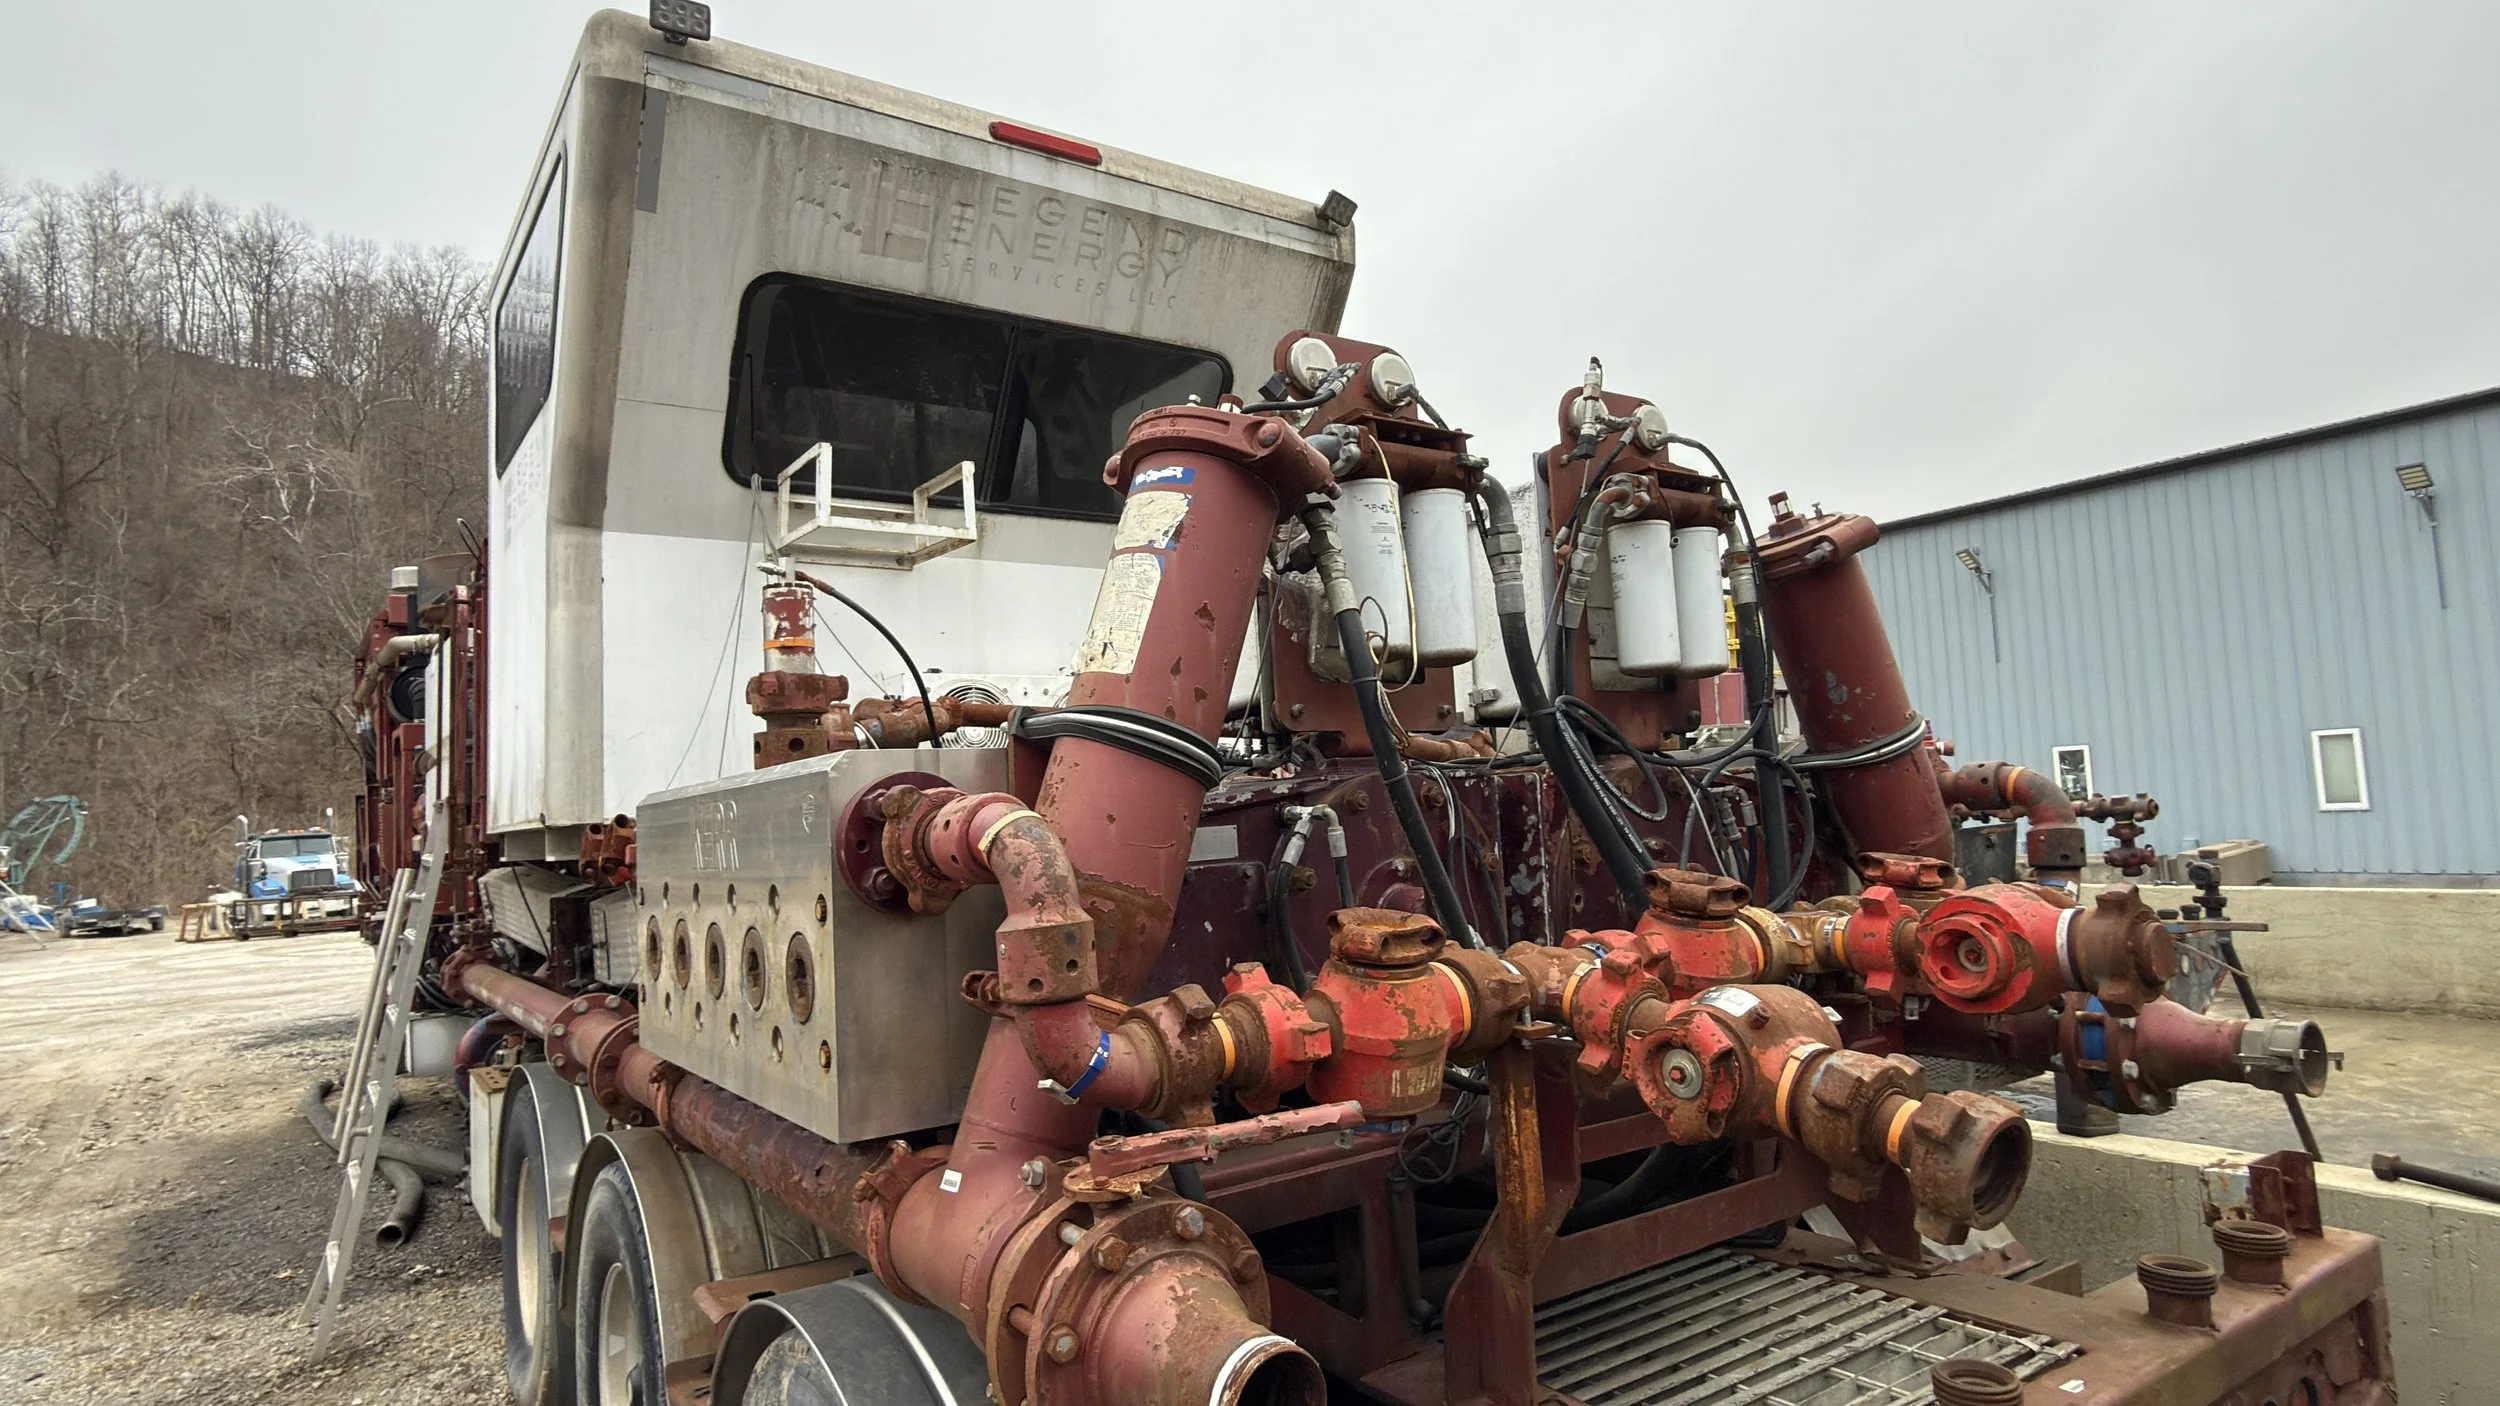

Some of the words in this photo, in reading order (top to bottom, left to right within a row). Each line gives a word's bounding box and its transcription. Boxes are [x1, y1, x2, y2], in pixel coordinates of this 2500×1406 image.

[940, 253, 1105, 297] SERVICES
[1129, 287, 1177, 310] LLC
[950, 215, 1183, 289] ENERGY
